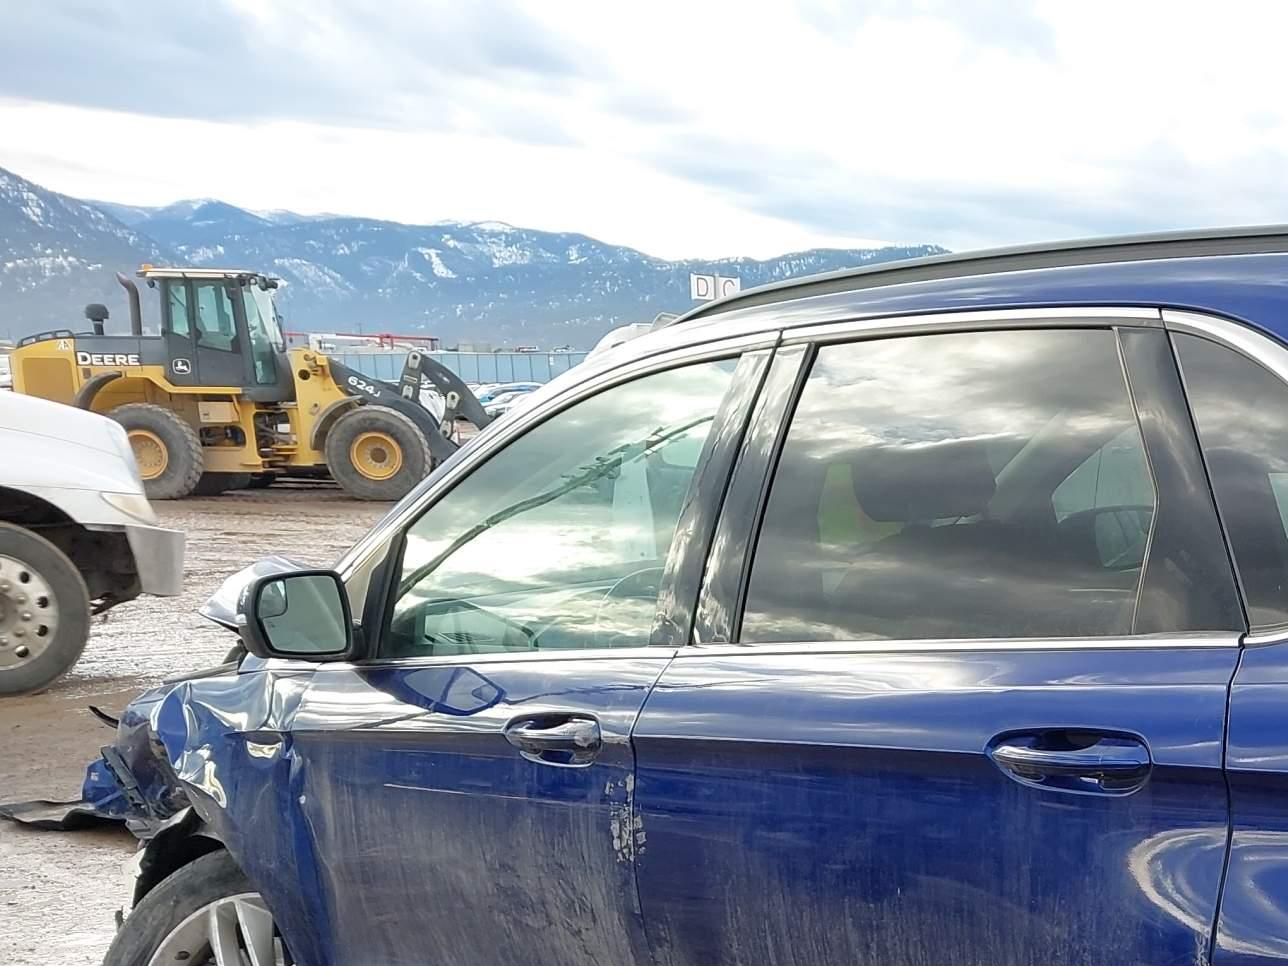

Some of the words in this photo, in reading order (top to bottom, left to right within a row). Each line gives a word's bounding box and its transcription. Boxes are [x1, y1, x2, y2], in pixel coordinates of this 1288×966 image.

[696, 277, 709, 297] D
[76, 352, 140, 366] DEERE
[347, 376, 381, 397] 624J
